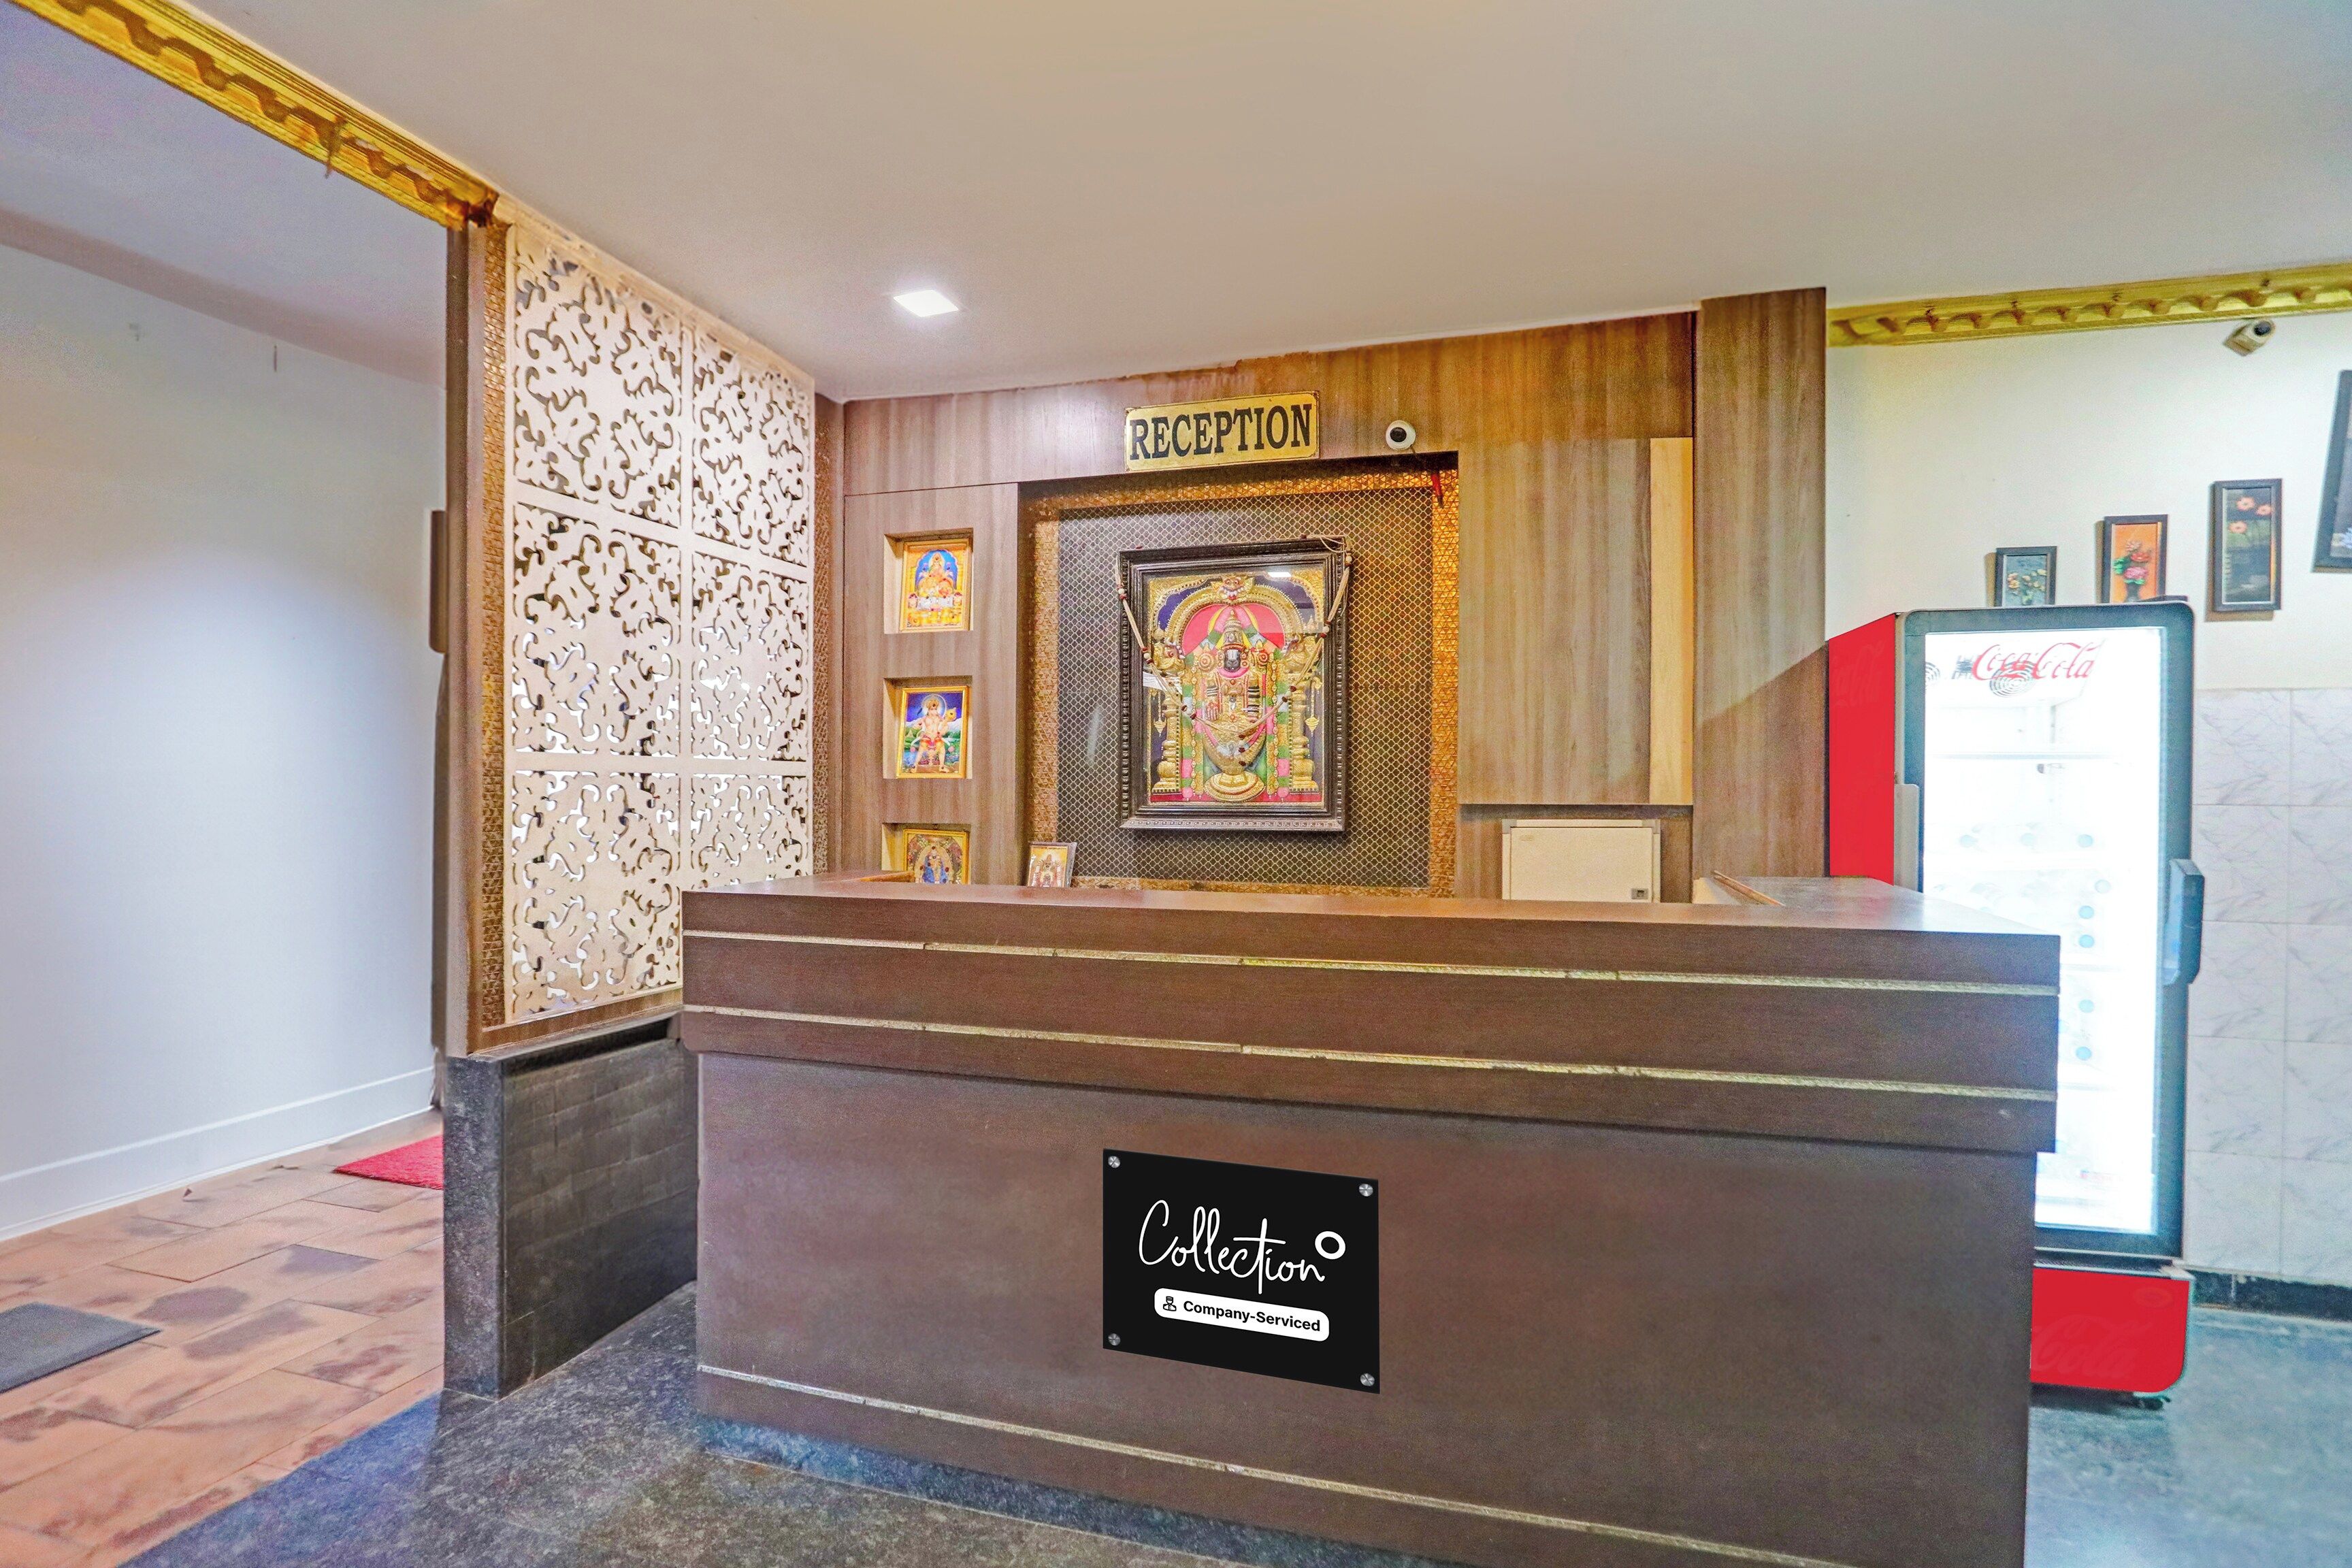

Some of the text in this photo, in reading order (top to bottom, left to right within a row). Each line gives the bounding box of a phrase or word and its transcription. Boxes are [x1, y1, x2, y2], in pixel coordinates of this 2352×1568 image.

[1129, 404, 1312, 460] RECEPTION
[1139, 1199, 1326, 1294] Collection
[1183, 1301, 1321, 1332] Company-Serviced
